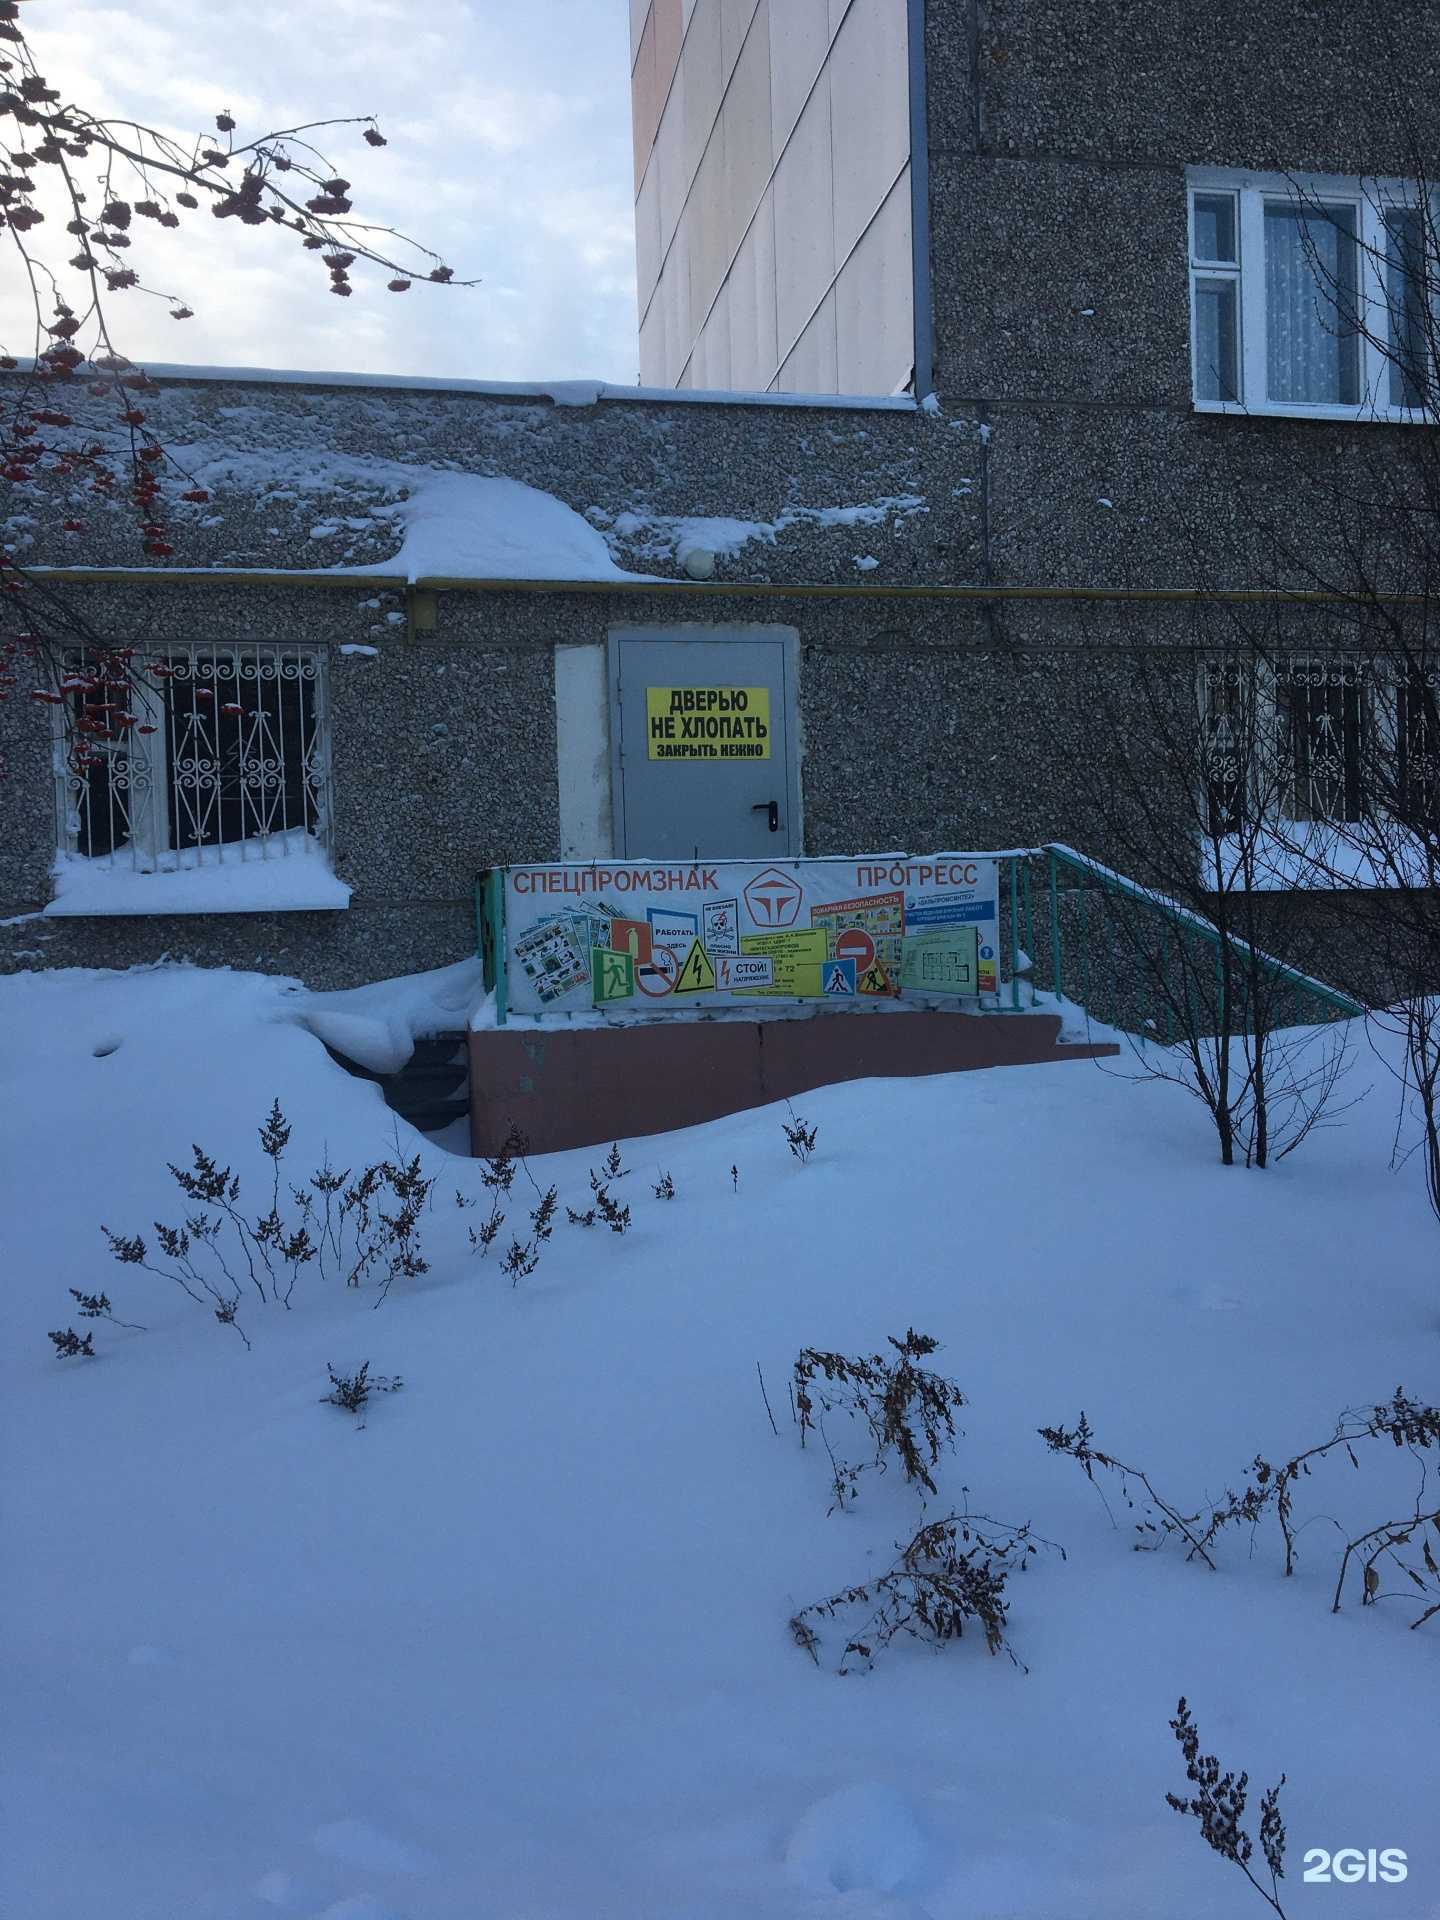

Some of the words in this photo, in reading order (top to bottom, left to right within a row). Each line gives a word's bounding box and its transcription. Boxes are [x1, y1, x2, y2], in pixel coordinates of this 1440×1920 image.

[669, 690, 748, 715] ДВЕРЬЮ
[651, 717, 675, 738] НЕ
[681, 717, 768, 739] ХЛОПАТЬ
[657, 744, 717, 757] ЗАКРЫТЬ
[720, 743, 763, 757] НЕЖНО
[513, 869, 719, 897] СПЕЦПРОМЗНАК
[857, 863, 978, 887] ПРОГРЕСС
[843, 896, 899, 910] БЕЗОПАСНОСТЬ
[655, 928, 694, 936] РАБОТАТЬ
[736, 961, 767, 974] СТОЙ!
